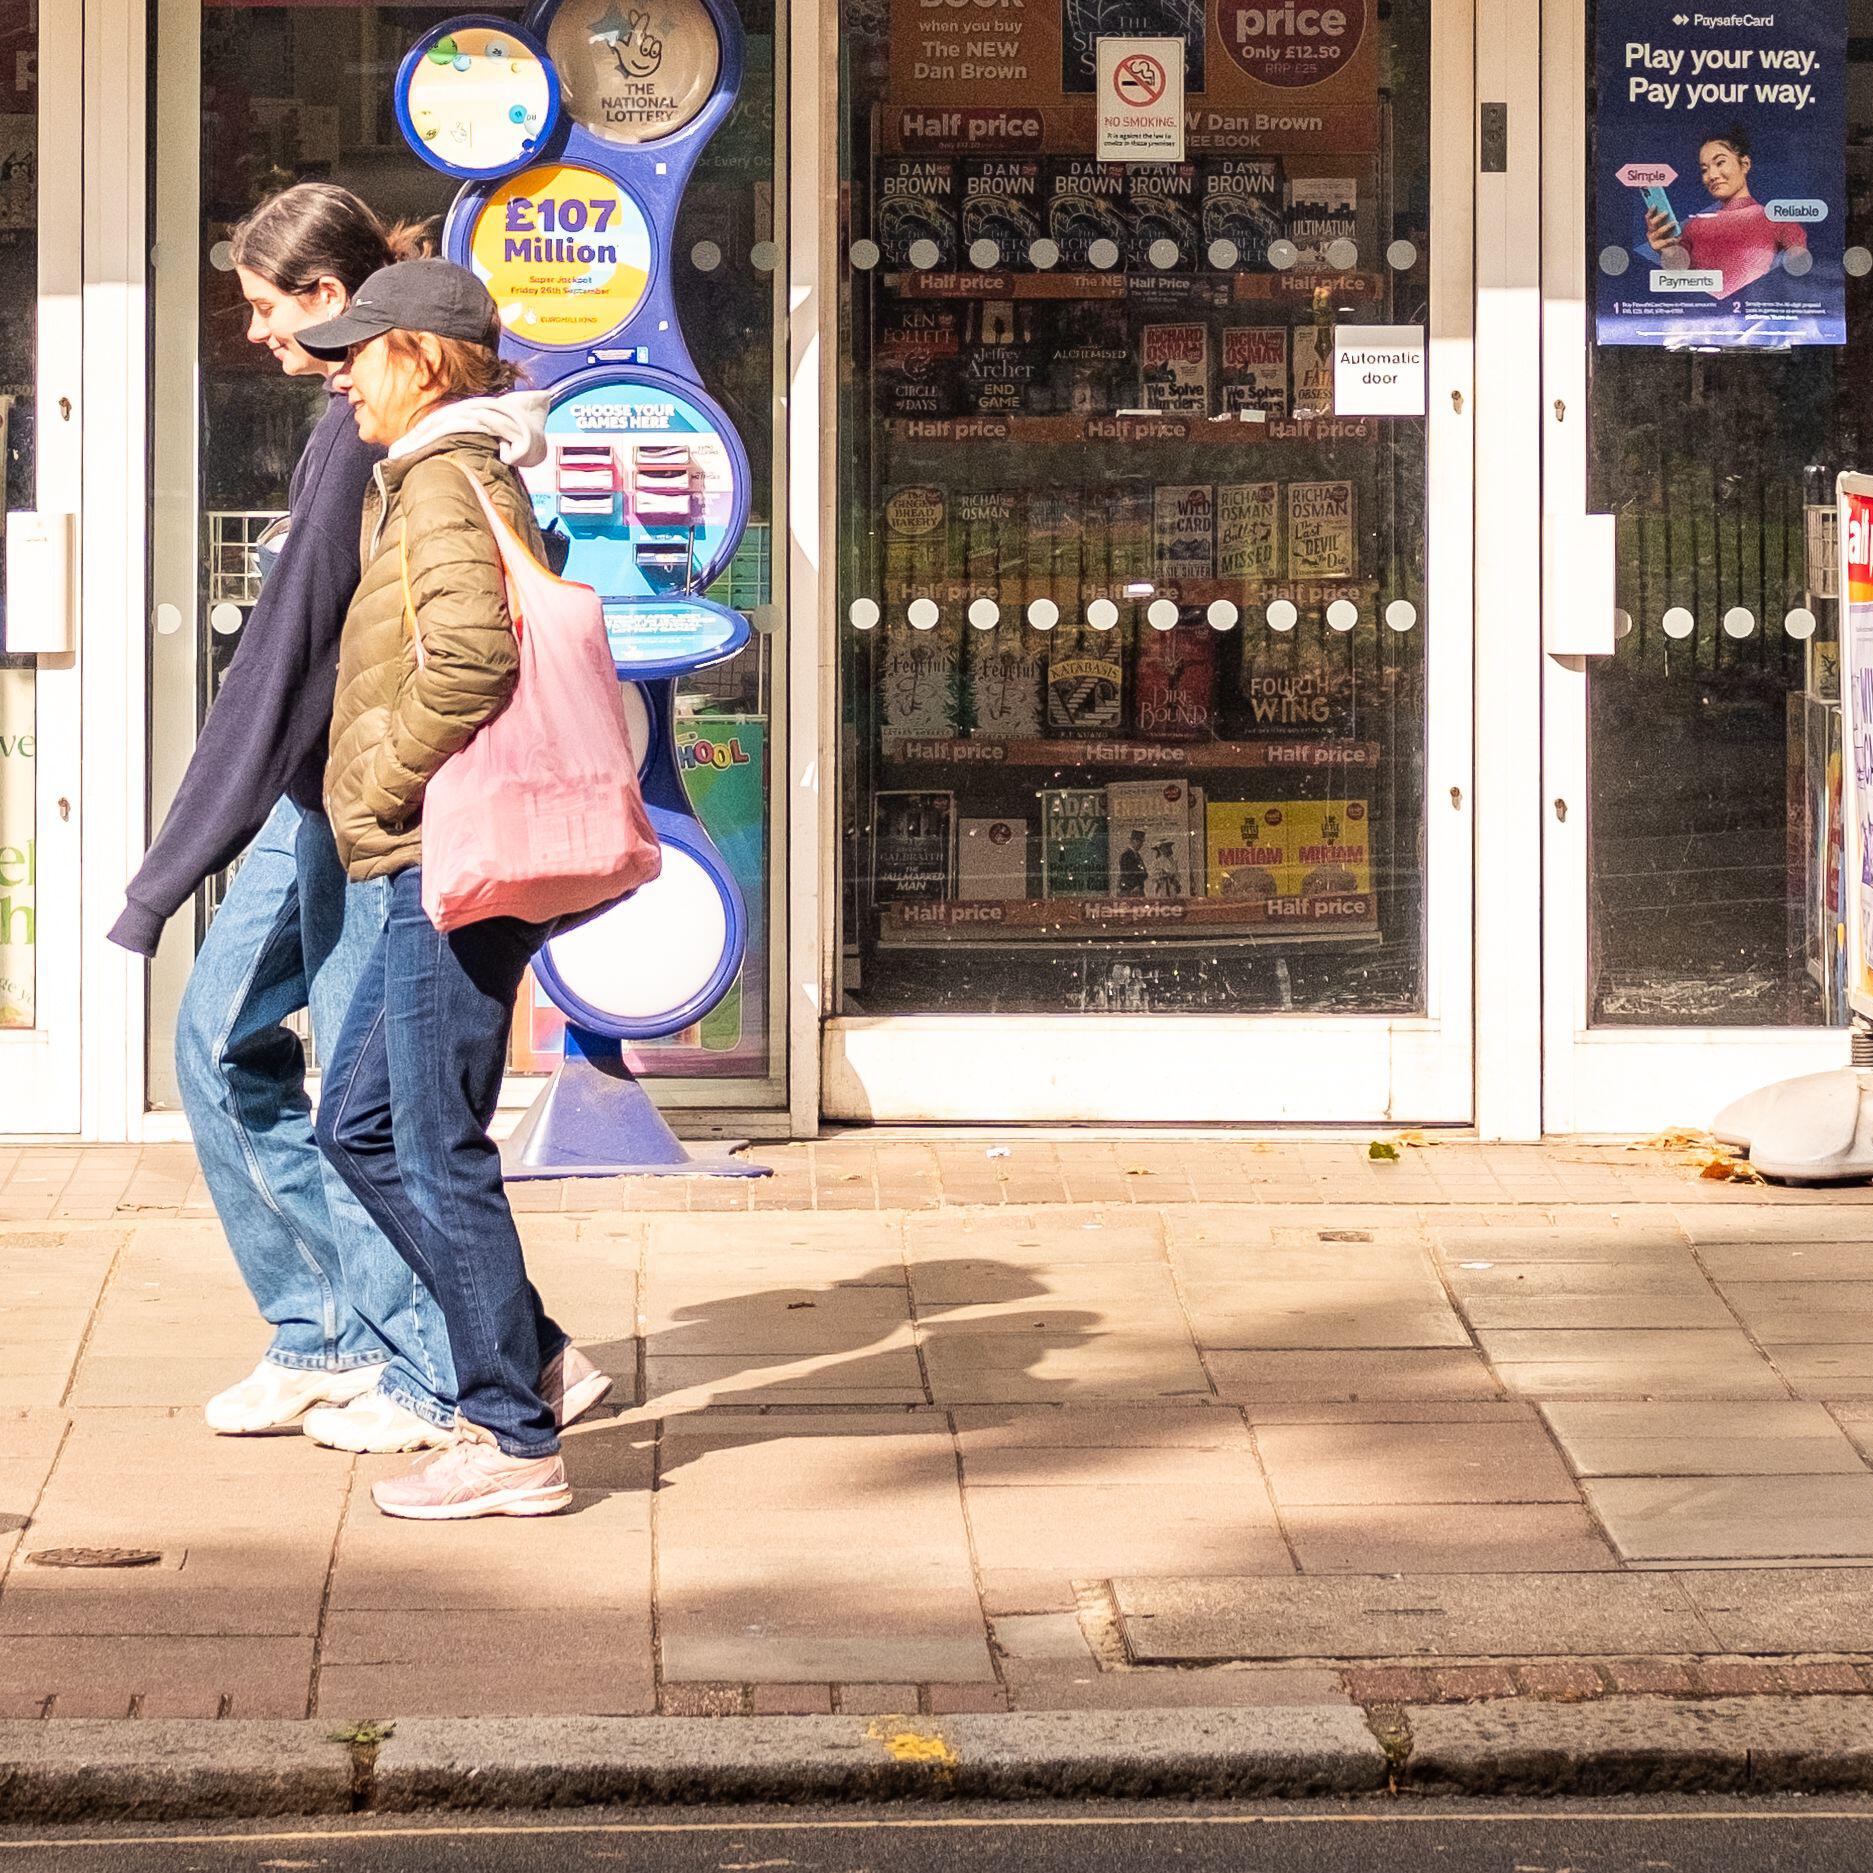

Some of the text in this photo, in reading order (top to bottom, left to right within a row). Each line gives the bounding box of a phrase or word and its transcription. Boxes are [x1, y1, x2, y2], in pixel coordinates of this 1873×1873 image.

[919, 21, 1023, 35] when you buy
[1236, 0, 1348, 42] price
[1694, 14, 1774, 28] PaysafeCard
[922, 41, 1020, 58] The NEW
[1242, 45, 1342, 60] Only £12.50
[1625, 43, 1821, 75] Play your way.
[913, 62, 1028, 80] Dan Brown
[624, 84, 655, 95] THE
[1629, 77, 1816, 109] Pay your way.
[602, 97, 678, 109] NATIONAL
[606, 110, 673, 122] LOTTERY
[1104, 117, 1121, 128] NO
[1207, 114, 1323, 131] Dan Brown
[902, 113, 1040, 141] Half price
[1212, 134, 1262, 148] BOOK
[1207, 175, 1275, 193] BROWN
[1627, 169, 1666, 184] Simple
[883, 177, 951, 194] BROWN
[505, 198, 617, 233] £107
[1773, 204, 1820, 217] Reliable
[1293, 219, 1356, 237] ULTIMATUM
[504, 237, 618, 265] Million
[1658, 275, 1714, 289] Payments
[510, 285, 539, 297] Friday
[1340, 352, 1420, 365] Automatic
[966, 359, 1036, 378] Archer
[1361, 373, 1398, 385] door
[983, 384, 1015, 395] END
[978, 396, 1021, 408] GAME
[569, 403, 675, 417] CHOOSE YOUR
[575, 416, 670, 429] GAMES HERE
[1250, 677, 1329, 696] FOURTH
[1250, 696, 1329, 724] WING
[677, 739, 750, 770] HOOL
[1267, 899, 1366, 921] Half price
